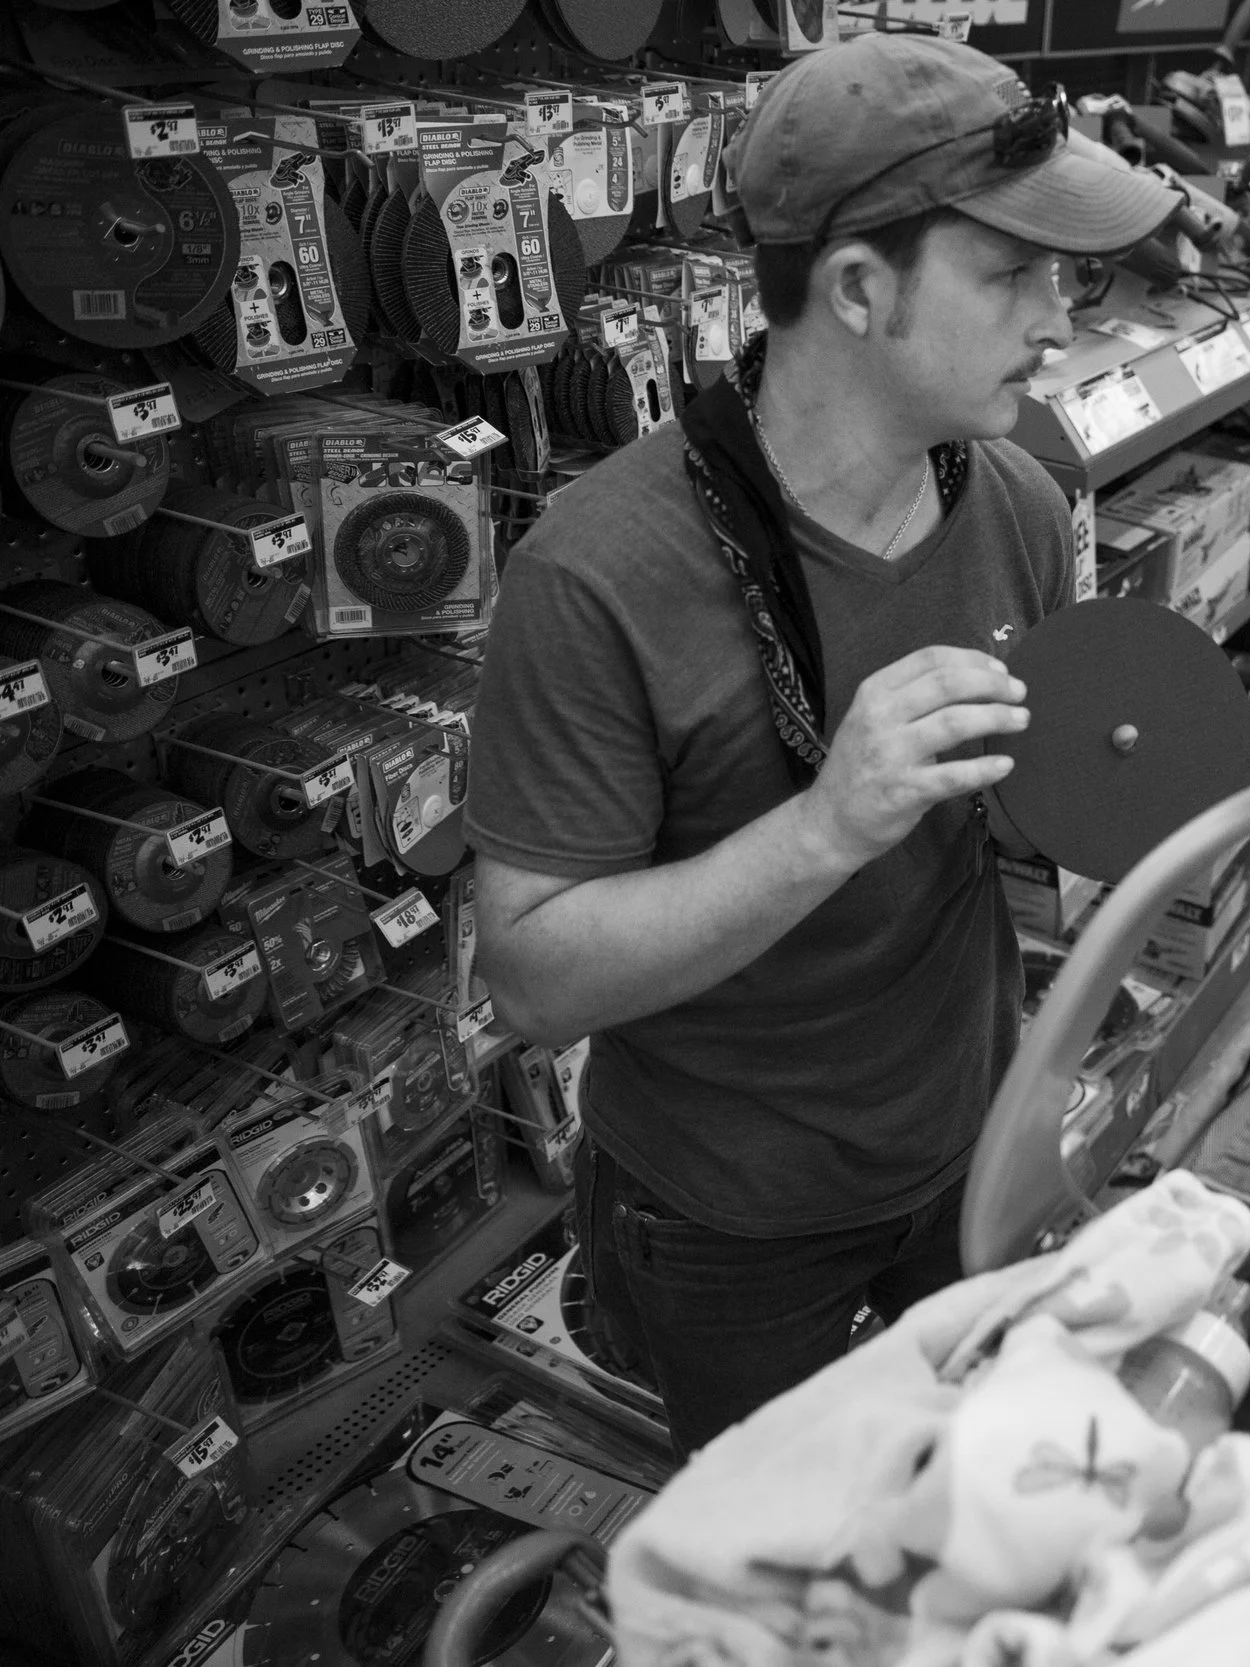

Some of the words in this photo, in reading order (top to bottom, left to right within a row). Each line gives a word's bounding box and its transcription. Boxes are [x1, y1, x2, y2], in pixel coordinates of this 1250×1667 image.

[310, 14, 324, 26] 29
[243, 47, 274, 55] GRINDING
[281, 44, 314, 53] POLISHING
[422, 134, 451, 142] DIABLO
[227, 147, 262, 155] POLISHING
[423, 152, 454, 160] GRINDING
[461, 149, 493, 157] POLISHING
[441, 158, 457, 166] DISC
[612, 157, 623, 167] 24
[611, 173, 619, 184] 4
[461, 187, 483, 195] DIABLO
[471, 201, 488, 212] 10x
[179, 211, 194, 232] 6
[295, 214, 311, 234] 7"
[520, 210, 536, 229] 7"
[521, 238, 541, 256] 60
[298, 246, 319, 264] 60
[529, 322, 541, 332] 29
[314, 338, 326, 347] 29
[475, 352, 500, 361] GRINDING
[504, 347, 531, 356] POLISHING
[257, 371, 284, 380] GRINDING
[289, 365, 317, 375] POLISHING
[325, 438, 355, 447] DIABLO
[443, 603, 475, 611] GRINDING
[441, 609, 475, 617] POLISHING
[384, 752, 406, 772] DIABLO
[231, 1119, 273, 1145] RIDGID
[70, 1211, 121, 1247] RIDGID
[482, 1252, 548, 1305] RIDGID
[419, 1433, 454, 1469] 14"
[353, 1534, 418, 1603] RIDGID
